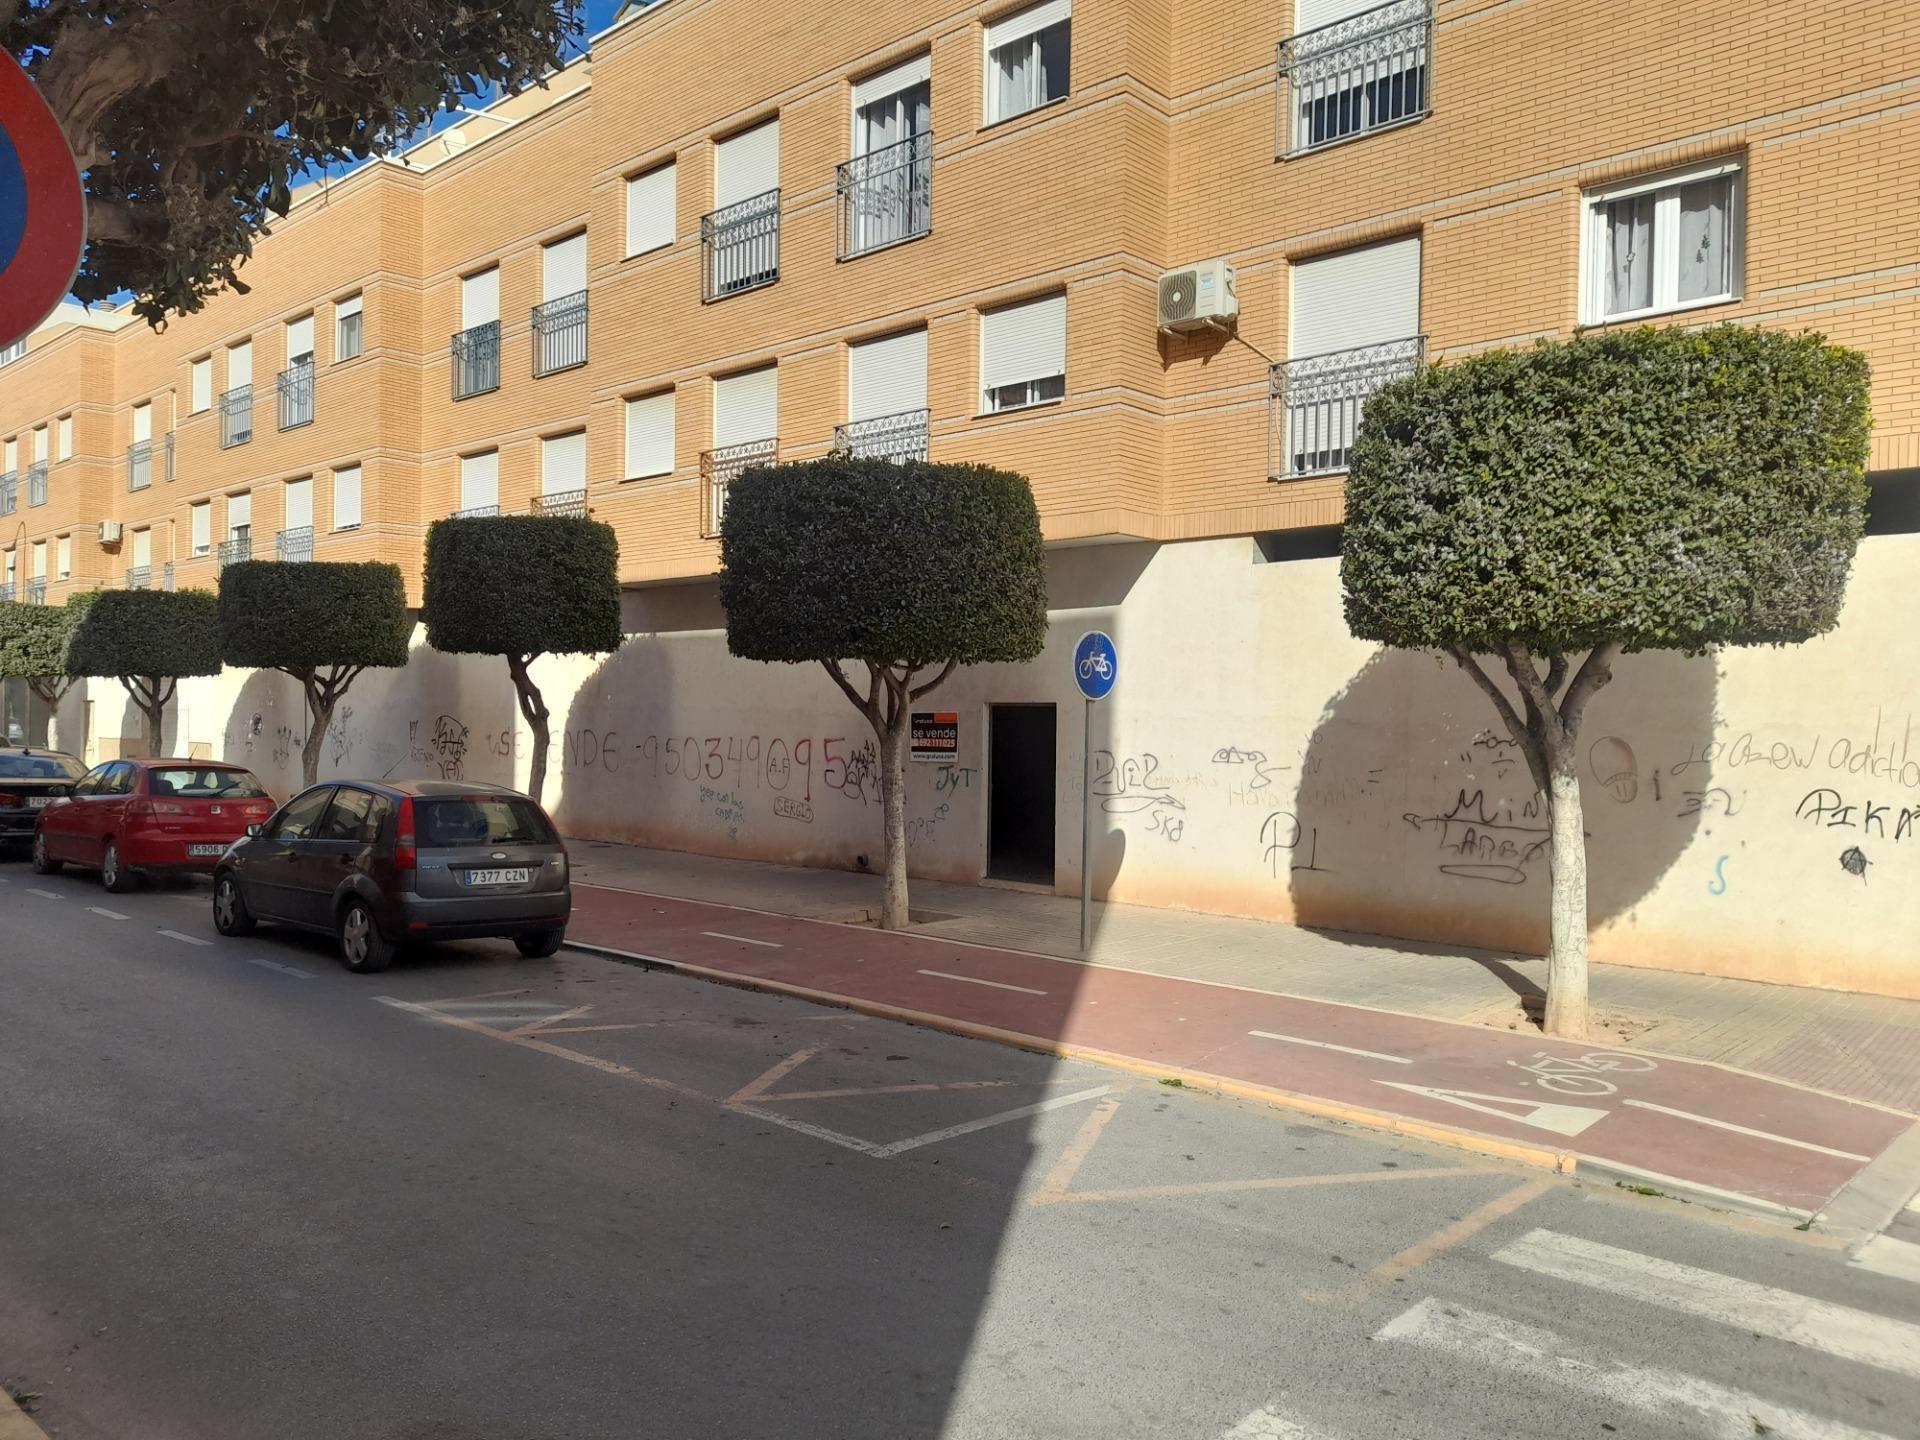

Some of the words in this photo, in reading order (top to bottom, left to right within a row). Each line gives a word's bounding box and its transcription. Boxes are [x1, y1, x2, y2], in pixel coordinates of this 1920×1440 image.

[912, 729, 924, 738] se
[926, 727, 956, 738] vende
[548, 728, 620, 774] ENDE
[195, 845, 219, 855] 5906
[472, 871, 500, 883] 7377
[505, 870, 526, 882] CZN
